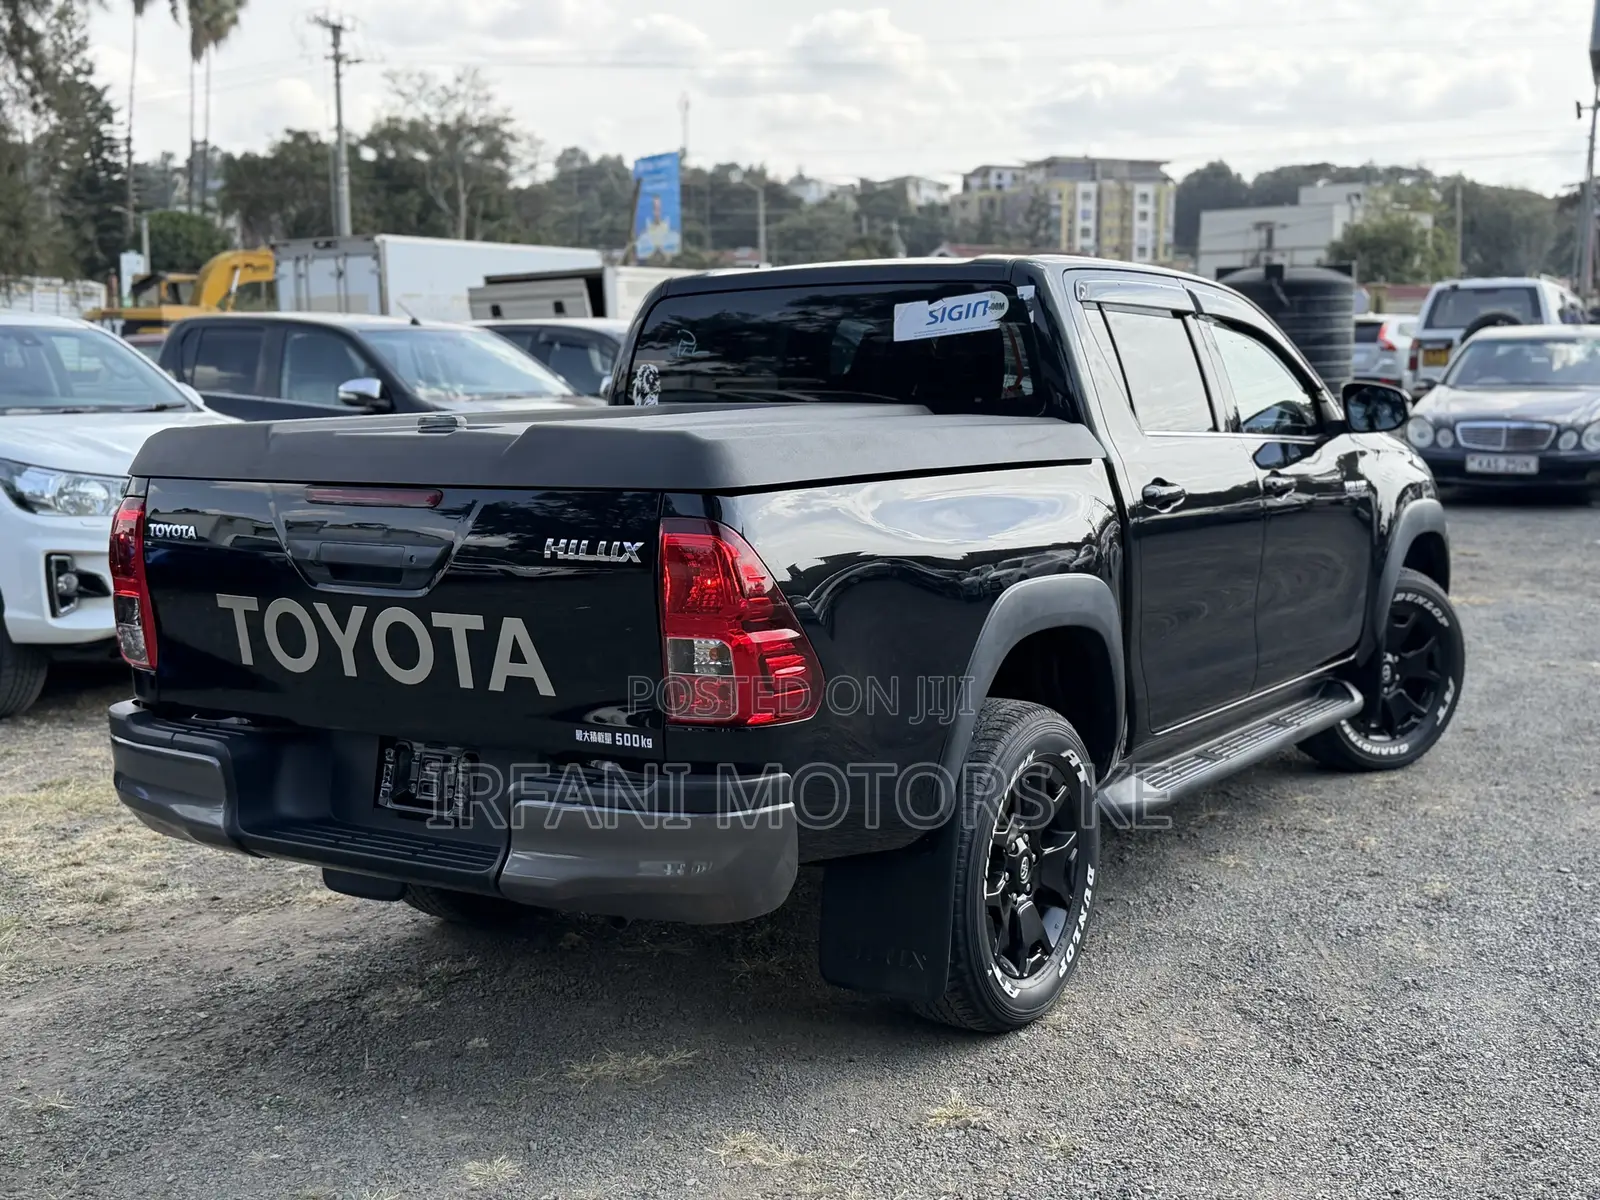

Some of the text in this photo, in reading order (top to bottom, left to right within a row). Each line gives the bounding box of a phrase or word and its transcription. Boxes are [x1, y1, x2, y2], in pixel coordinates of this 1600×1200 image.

[148, 523, 197, 540] TOYOTA
[544, 538, 645, 563] HILUX
[1393, 593, 1450, 628] DUNLOP
[216, 593, 556, 697] TOYOTA
[615, 732, 653, 749] 500kg
[1059, 863, 1095, 978] DUNLOP
